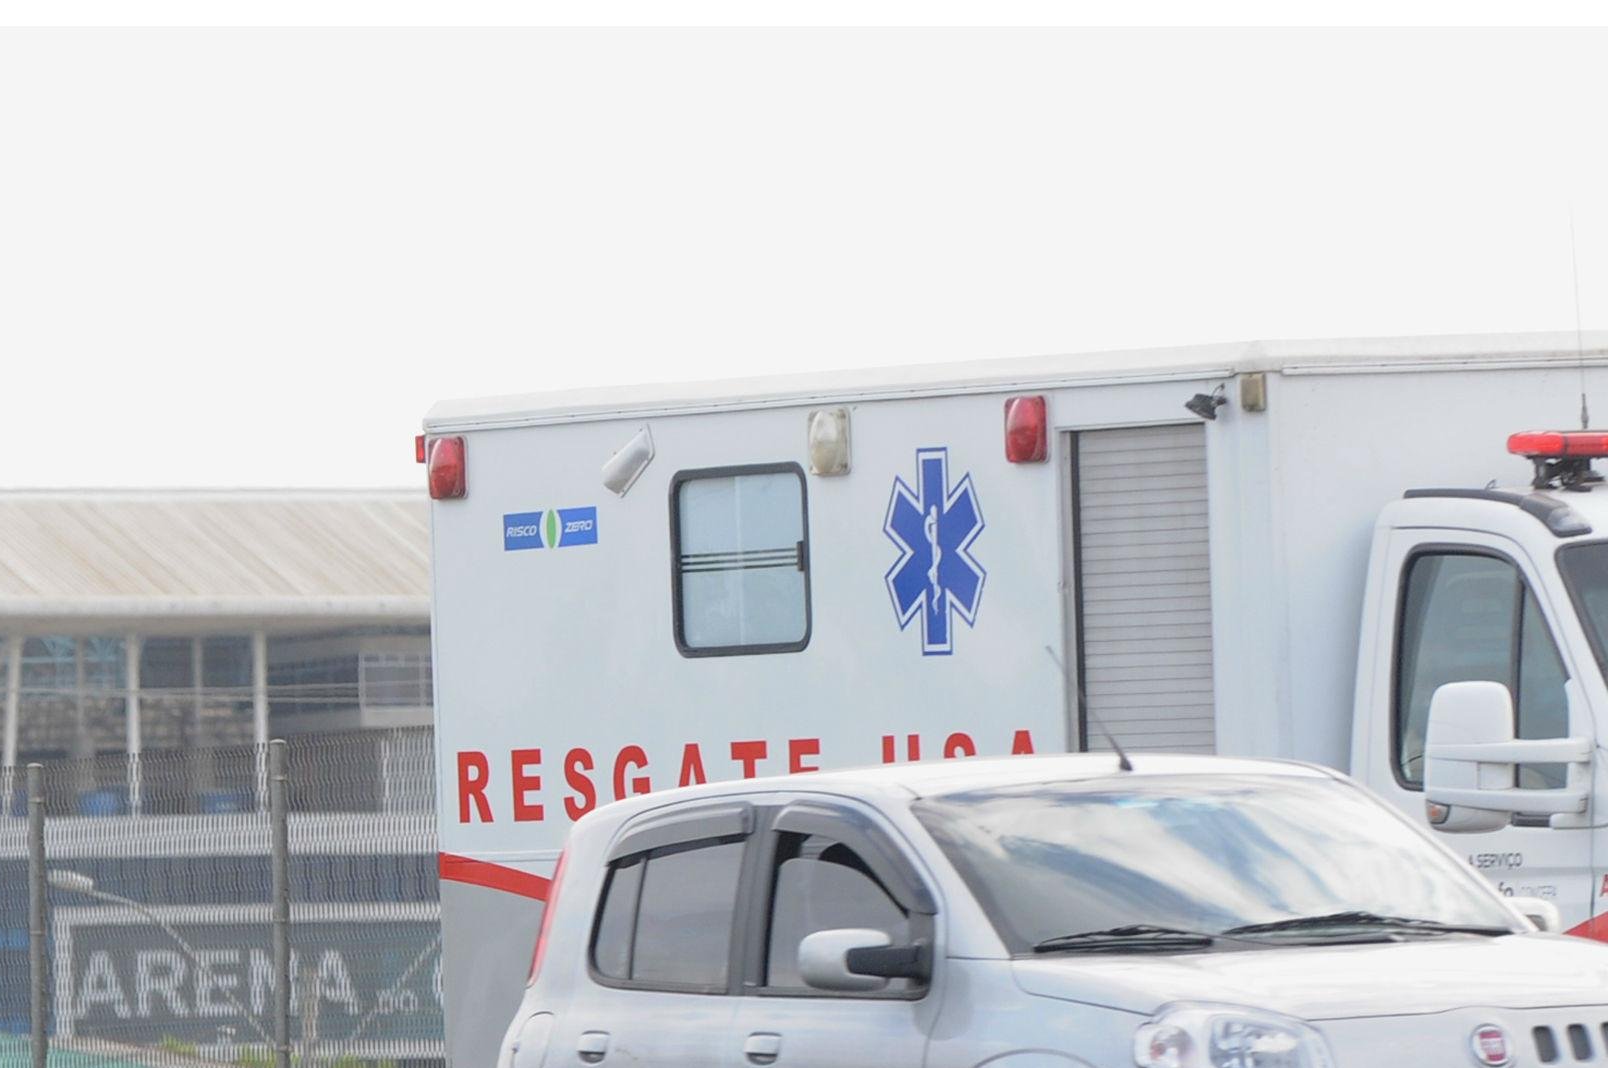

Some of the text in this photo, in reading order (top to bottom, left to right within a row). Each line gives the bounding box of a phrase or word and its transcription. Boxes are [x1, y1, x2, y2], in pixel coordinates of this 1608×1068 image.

[506, 520, 593, 537] RISCO ZERO
[76, 949, 359, 1019] ARENA
